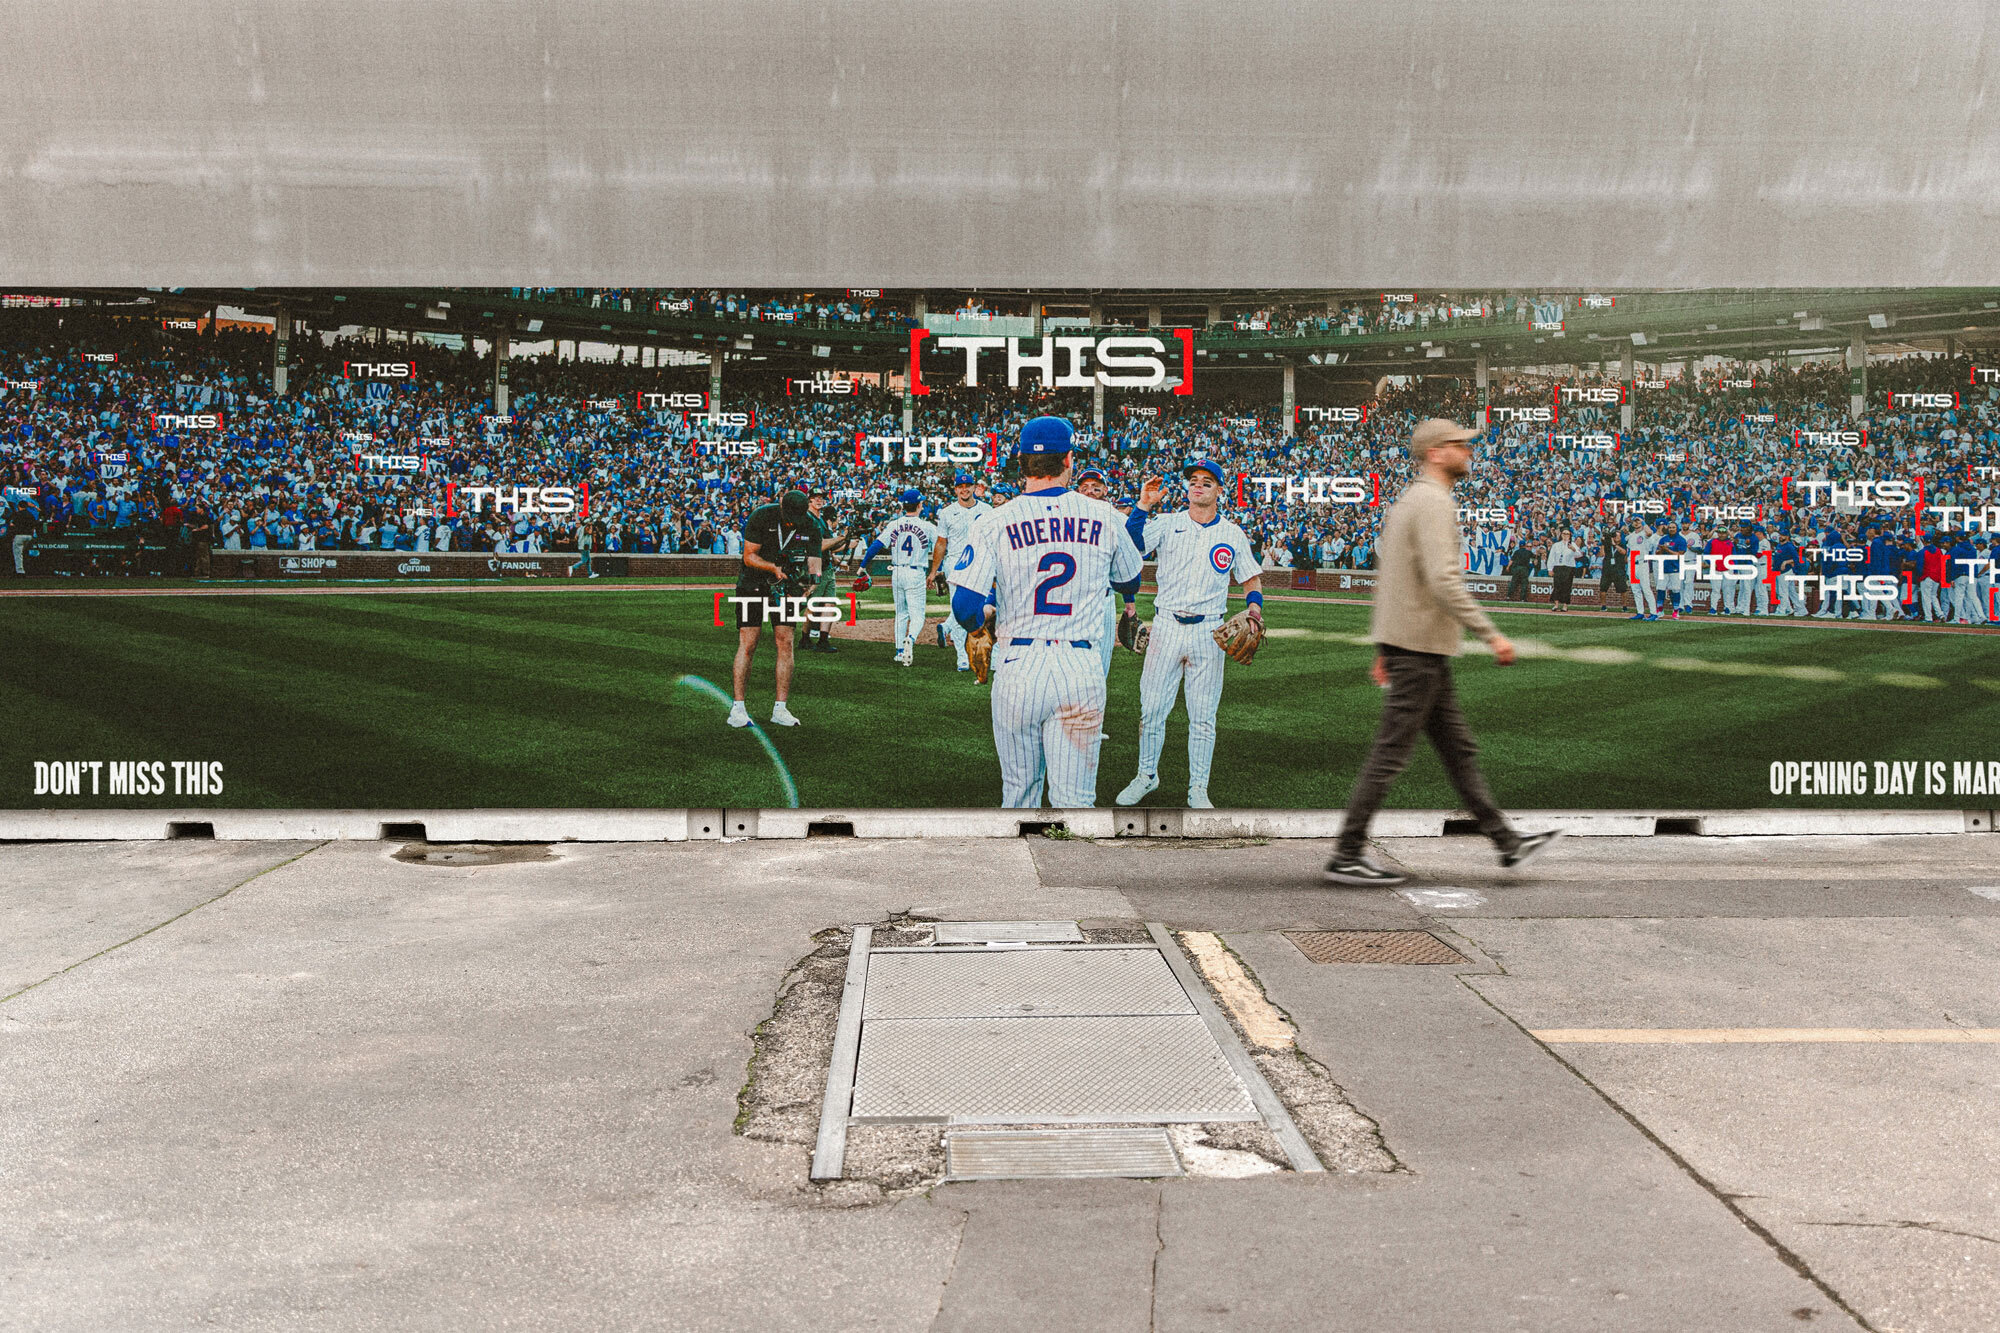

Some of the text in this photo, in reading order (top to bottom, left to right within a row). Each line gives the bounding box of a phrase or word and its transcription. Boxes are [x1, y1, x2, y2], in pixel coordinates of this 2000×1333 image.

[1006, 517, 1102, 550] HOERNER
[901, 535, 913, 556] 4
[301, 557, 326, 568] SHOP
[398, 563, 431, 574] Corona
[501, 561, 541, 570] FANDUEL
[1034, 552, 1077, 615] 2
[1465, 583, 1496, 592] EICO
[34, 761, 224, 795] DON'T MISS THIS
[1770, 761, 2000, 795] OPENING DAY IS MAR
